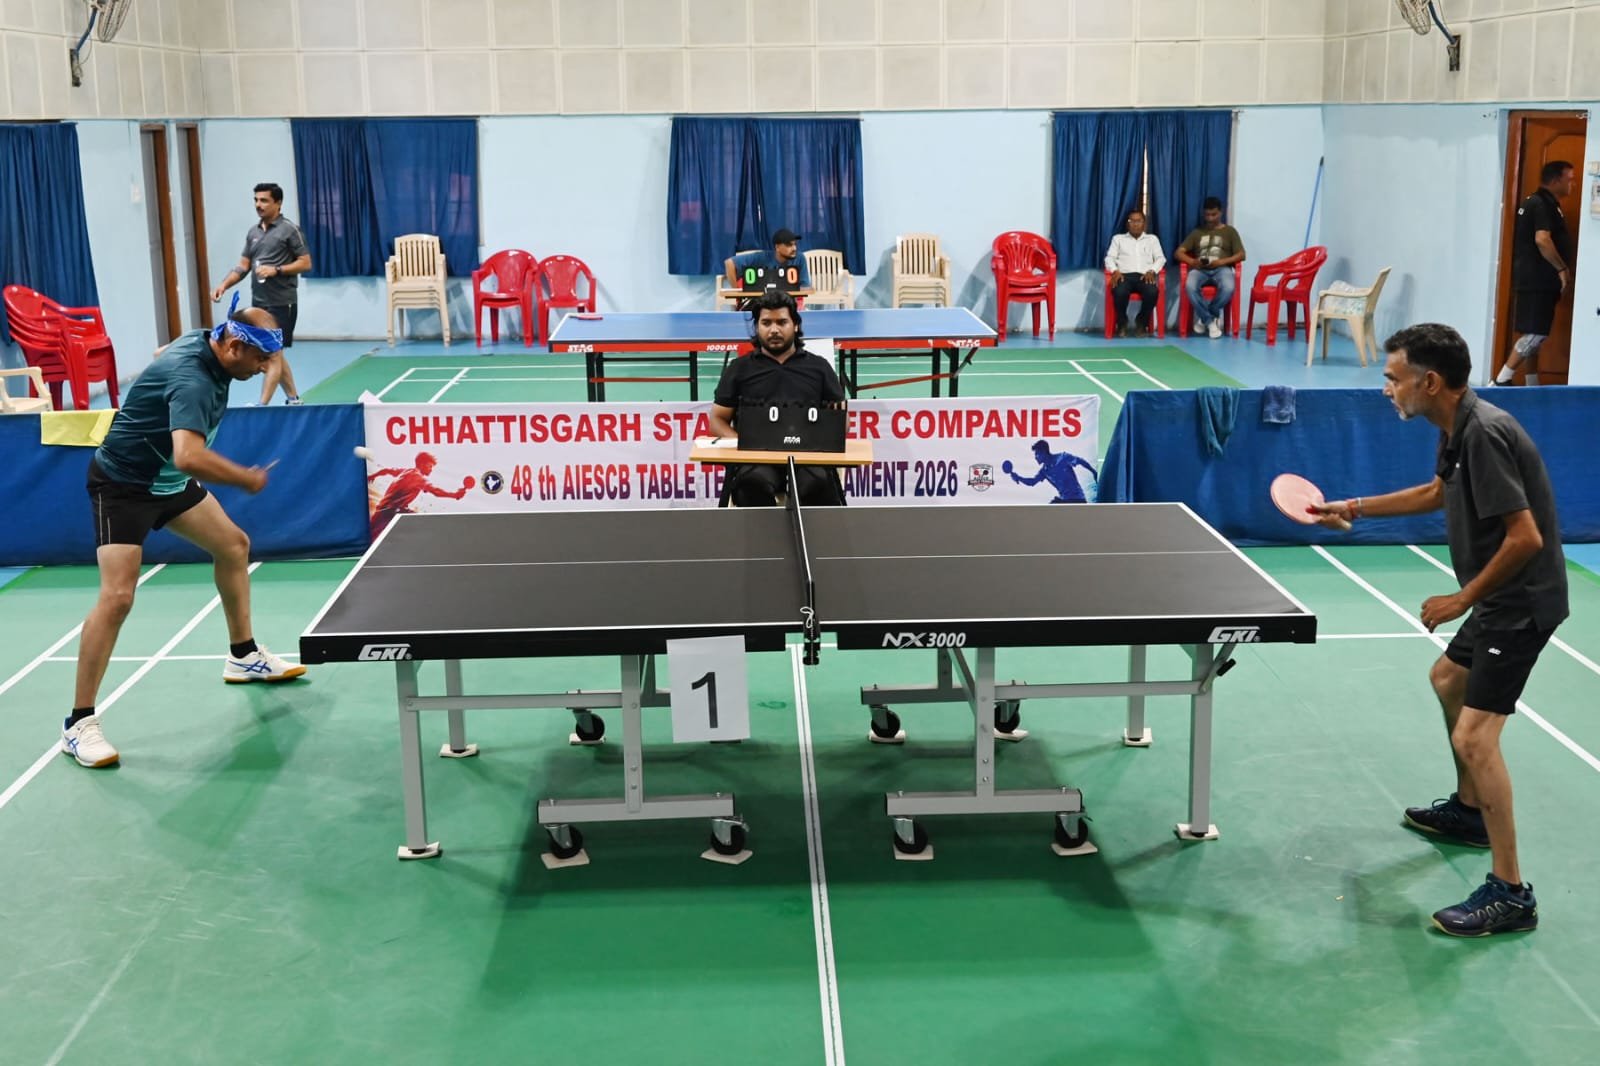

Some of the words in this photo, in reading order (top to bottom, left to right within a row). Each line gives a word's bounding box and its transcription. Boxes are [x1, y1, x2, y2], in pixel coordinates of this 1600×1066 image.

[745, 268, 756, 284] 0
[787, 267, 798, 284] 0
[769, 406, 779, 422] 0
[808, 407, 818, 422] 0
[386, 413, 642, 445] CHHATTISGARH
[653, 412, 712, 441] STA
[891, 408, 1082, 439] COMPANIES
[511, 464, 533, 501] 48
[538, 465, 557, 500] th
[562, 463, 631, 500] AIESCB
[636, 463, 696, 499] TABLE
[844, 461, 909, 497] AMENT
[914, 460, 958, 497] 2026
[1207, 626, 1260, 643] GKI
[358, 643, 411, 661] GKI
[691, 671, 718, 728] 1
